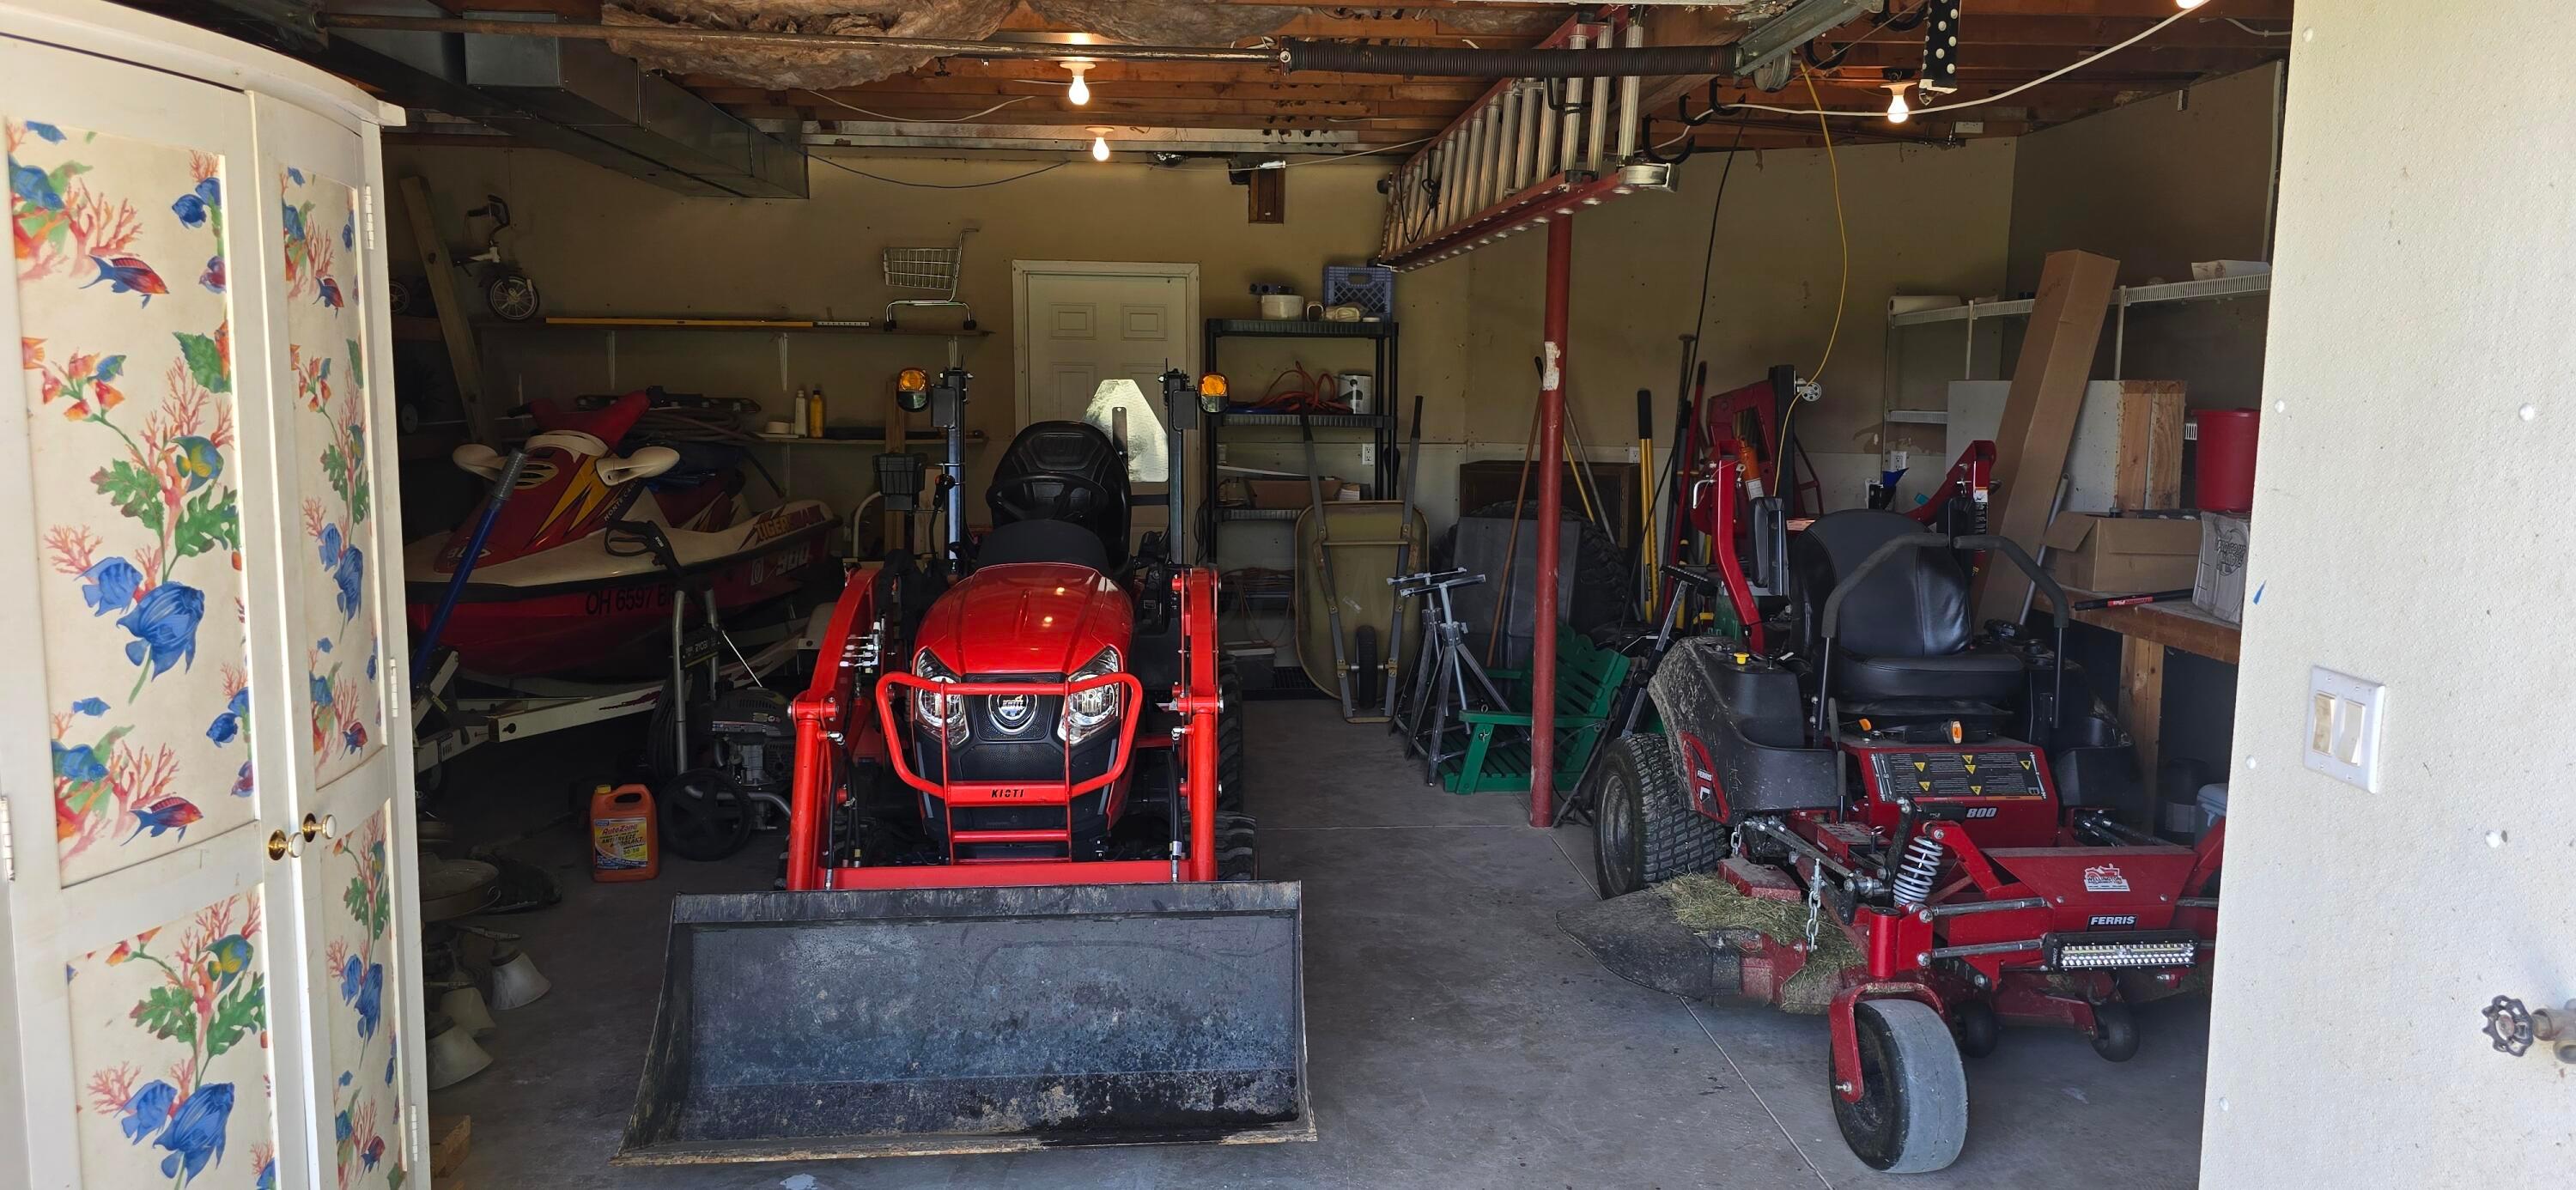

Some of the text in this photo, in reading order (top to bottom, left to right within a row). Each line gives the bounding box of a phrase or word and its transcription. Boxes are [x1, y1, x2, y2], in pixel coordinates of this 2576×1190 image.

[586, 590, 611, 615] OH
[616, 586, 653, 611] 6597
[991, 788, 1024, 798] KIOTI
[1965, 807, 1997, 818] 800
[2090, 915, 2136, 926] FERRIS
